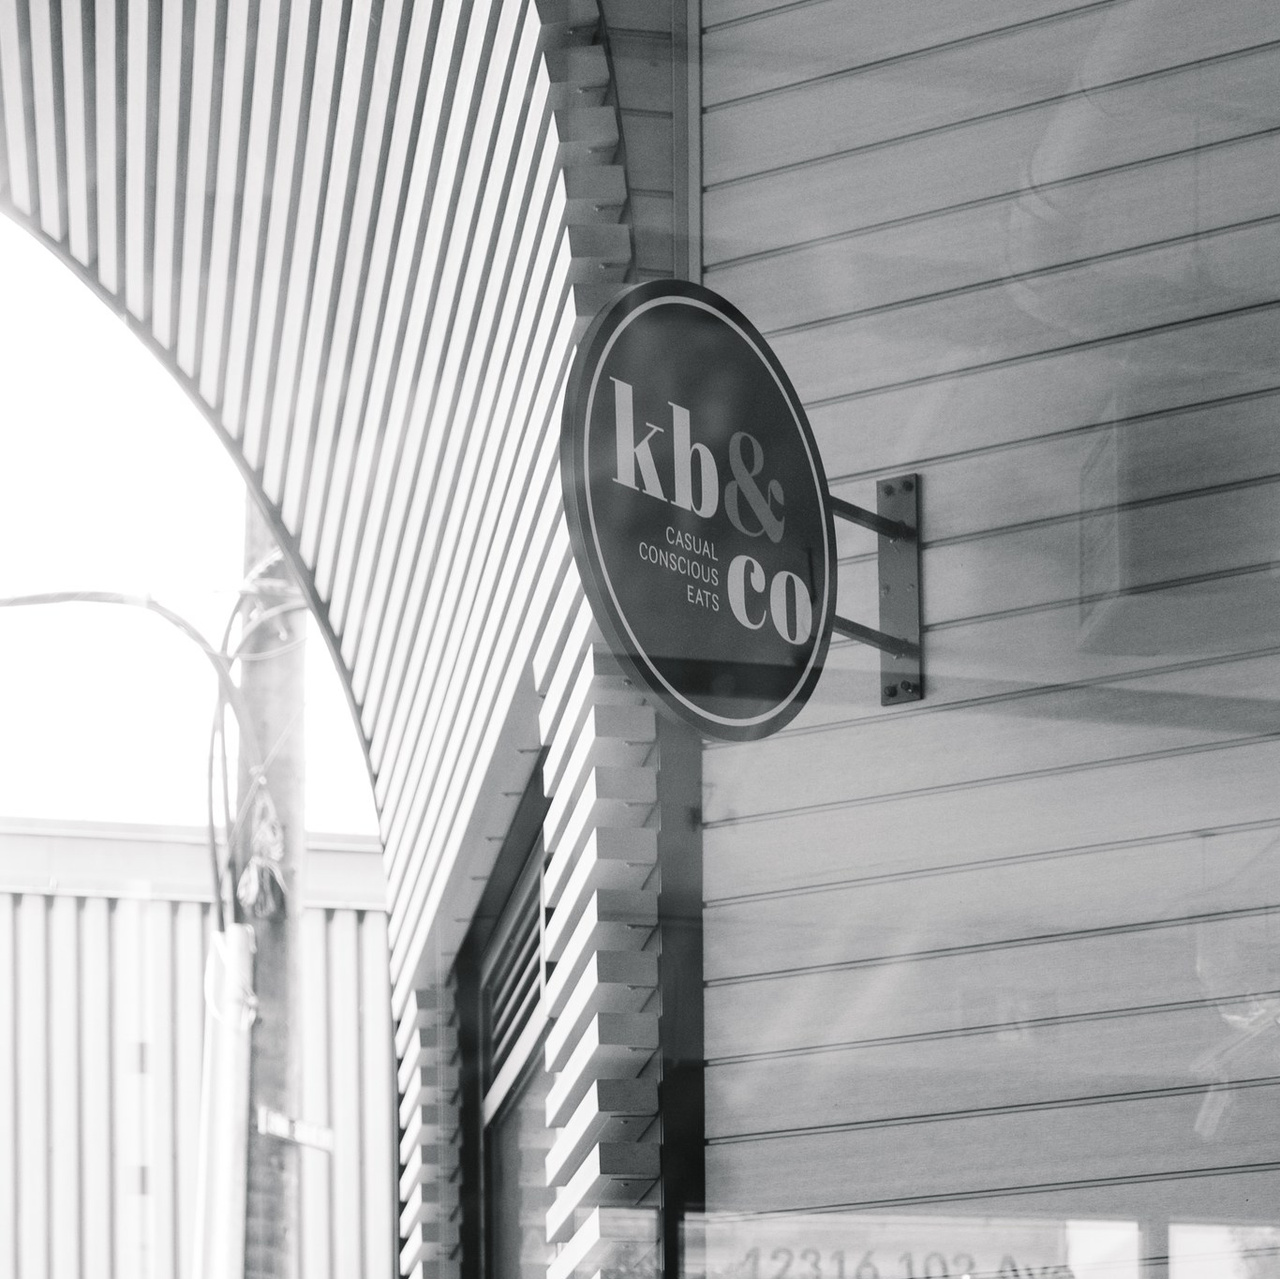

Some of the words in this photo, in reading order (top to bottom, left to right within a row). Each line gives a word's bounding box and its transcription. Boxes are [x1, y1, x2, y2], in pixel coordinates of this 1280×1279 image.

[609, 376, 785, 544] kb&
[638, 542, 719, 586] CONSCIOUS
[665, 526, 719, 561] CASUAL
[687, 584, 720, 612] EATS
[727, 555, 813, 646] co
